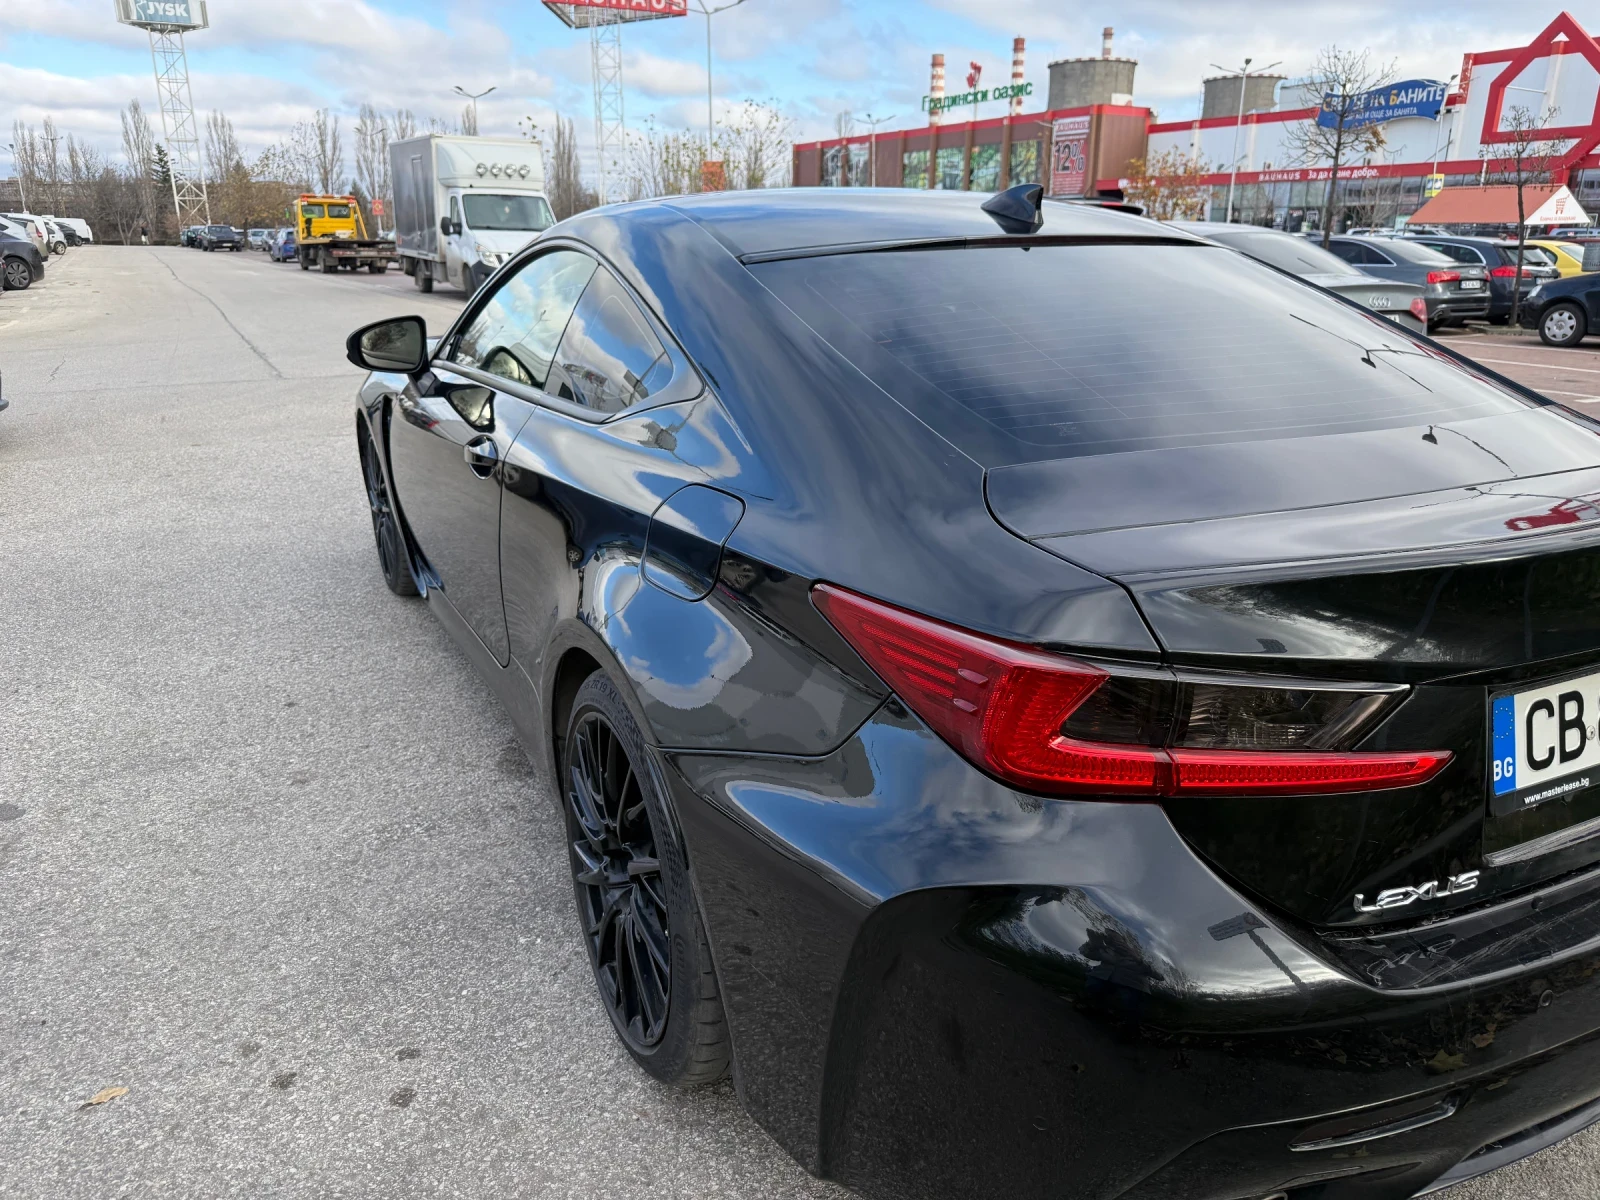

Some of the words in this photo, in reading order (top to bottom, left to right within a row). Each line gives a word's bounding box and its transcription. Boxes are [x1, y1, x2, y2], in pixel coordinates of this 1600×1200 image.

[147, 2, 189, 17] JYSK
[921, 89, 988, 114] Градински
[993, 82, 1033, 100] оазис
[1389, 87, 1444, 106] БАНИТЕ
[1055, 141, 1086, 173] 12%
[1258, 171, 1301, 182] BAUHAUS
[1525, 690, 1587, 771] CB
[1493, 757, 1513, 782] BG
[1523, 776, 1590, 805] www.masterlease.bg
[1353, 870, 1481, 913] LEXUS
